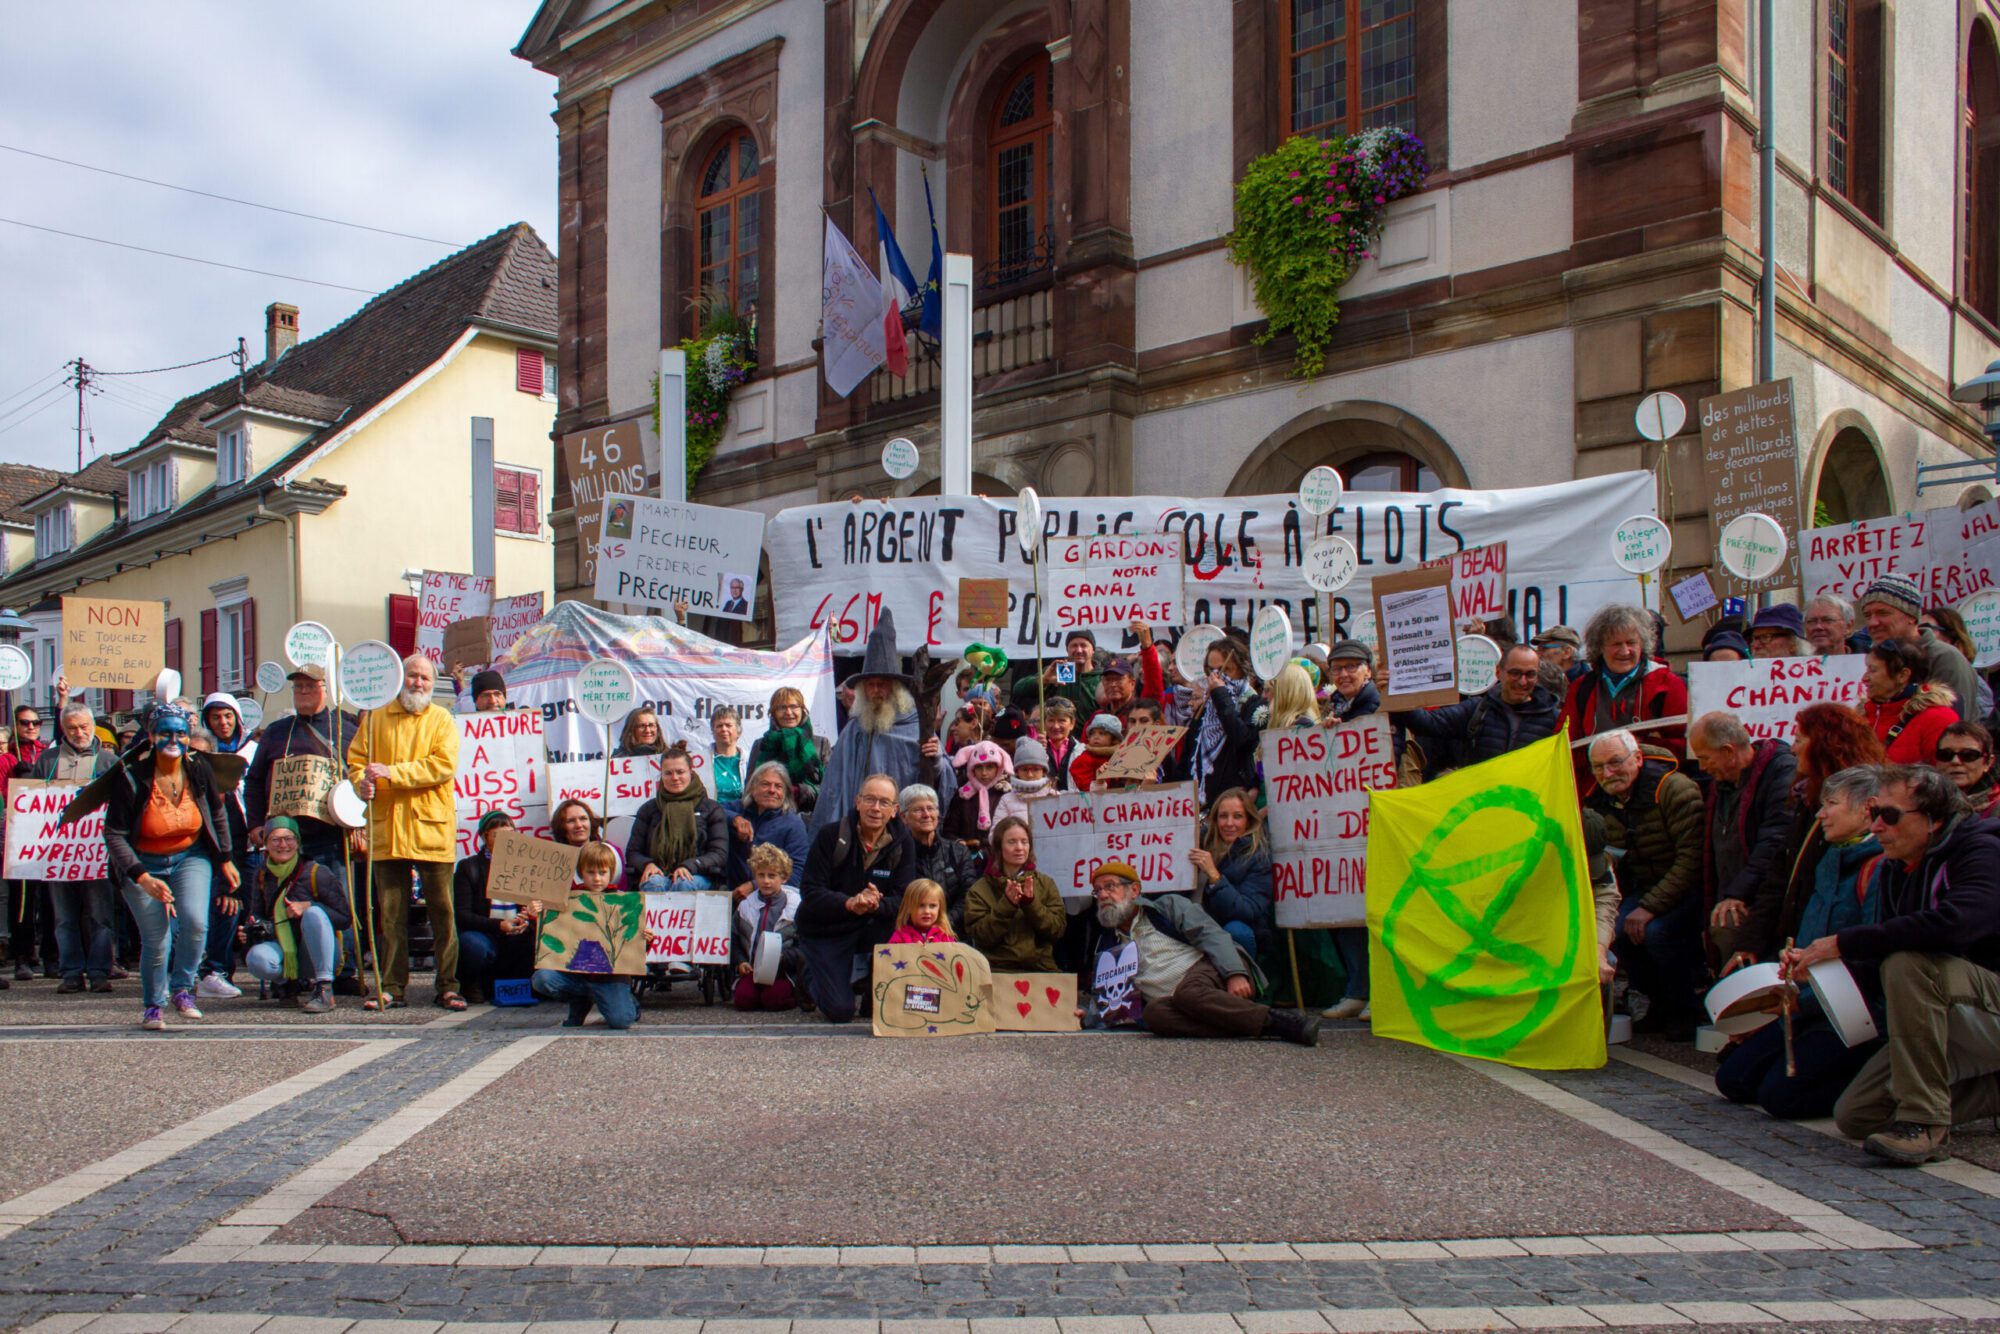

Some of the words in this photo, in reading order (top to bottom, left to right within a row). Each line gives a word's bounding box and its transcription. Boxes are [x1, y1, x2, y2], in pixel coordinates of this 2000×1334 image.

[1703, 402, 1728, 426] des
[1712, 426, 1727, 441] de
[1706, 447, 1725, 461] des
[1714, 492, 1733, 506] des
[1739, 482, 1789, 500] millions
[578, 511, 599, 533] pour
[1715, 508, 1740, 527] pour
[1283, 500, 1303, 567] À
[1313, 546, 1344, 561] POUR
[1726, 536, 1779, 555] PRÉSERVONS
[1461, 542, 1506, 579] BEAU
[1624, 548, 1654, 561] AIMER
[1742, 552, 1758, 570] !!!
[1112, 565, 1158, 578] NOTRE
[1838, 555, 1900, 580] VITE
[427, 572, 444, 589] 46
[1674, 579, 1706, 599] NATURE
[1063, 582, 1136, 598] CANAL
[1689, 592, 1700, 600] EN
[1682, 594, 1715, 615] DANGER
[1973, 601, 1998, 613] Pour
[88, 606, 141, 627] NON
[419, 611, 451, 629] VOUS
[1057, 602, 1172, 628] SAUVAGE
[1390, 621, 1396, 629] Il
[1397, 620, 1403, 629] y
[1404, 619, 1410, 627] a
[1411, 617, 1423, 625] 50
[1424, 615, 1440, 623] ans
[69, 630, 87, 643] NE
[96, 631, 147, 644] TOUCHEZ
[493, 631, 521, 649] VOUS
[1391, 631, 1424, 642] naissait
[1425, 628, 1433, 636] la
[99, 643, 122, 656] PAS
[1393, 642, 1431, 656] première
[1431, 640, 1450, 649] ZAD
[1978, 640, 1993, 653] lus
[81, 656, 110, 667] NOTRE
[123, 658, 152, 669] BEAU
[1394, 657, 1430, 668] d'Alsace
[1770, 659, 1823, 683] ROR
[88, 671, 135, 684] CANAL
[583, 680, 604, 688] SOIN
[609, 679, 619, 687] de
[606, 692, 631, 701] TERRE
[465, 711, 543, 739] NATURE
[1278, 733, 1326, 765] PAS
[1335, 727, 1379, 759] DE
[472, 745, 489, 768] A
[276, 759, 311, 775] TOUTE
[610, 759, 632, 776] LE
[296, 775, 317, 787] PAS
[1272, 757, 1398, 803] TRANCHÉES
[560, 787, 601, 800] NOUS
[14, 793, 75, 814] CANA
[1043, 806, 1096, 830] VOTRE
[1107, 833, 1133, 850] EST
[1141, 832, 1175, 846] UNE
[1096, 961, 1137, 983] STOCAMINE
